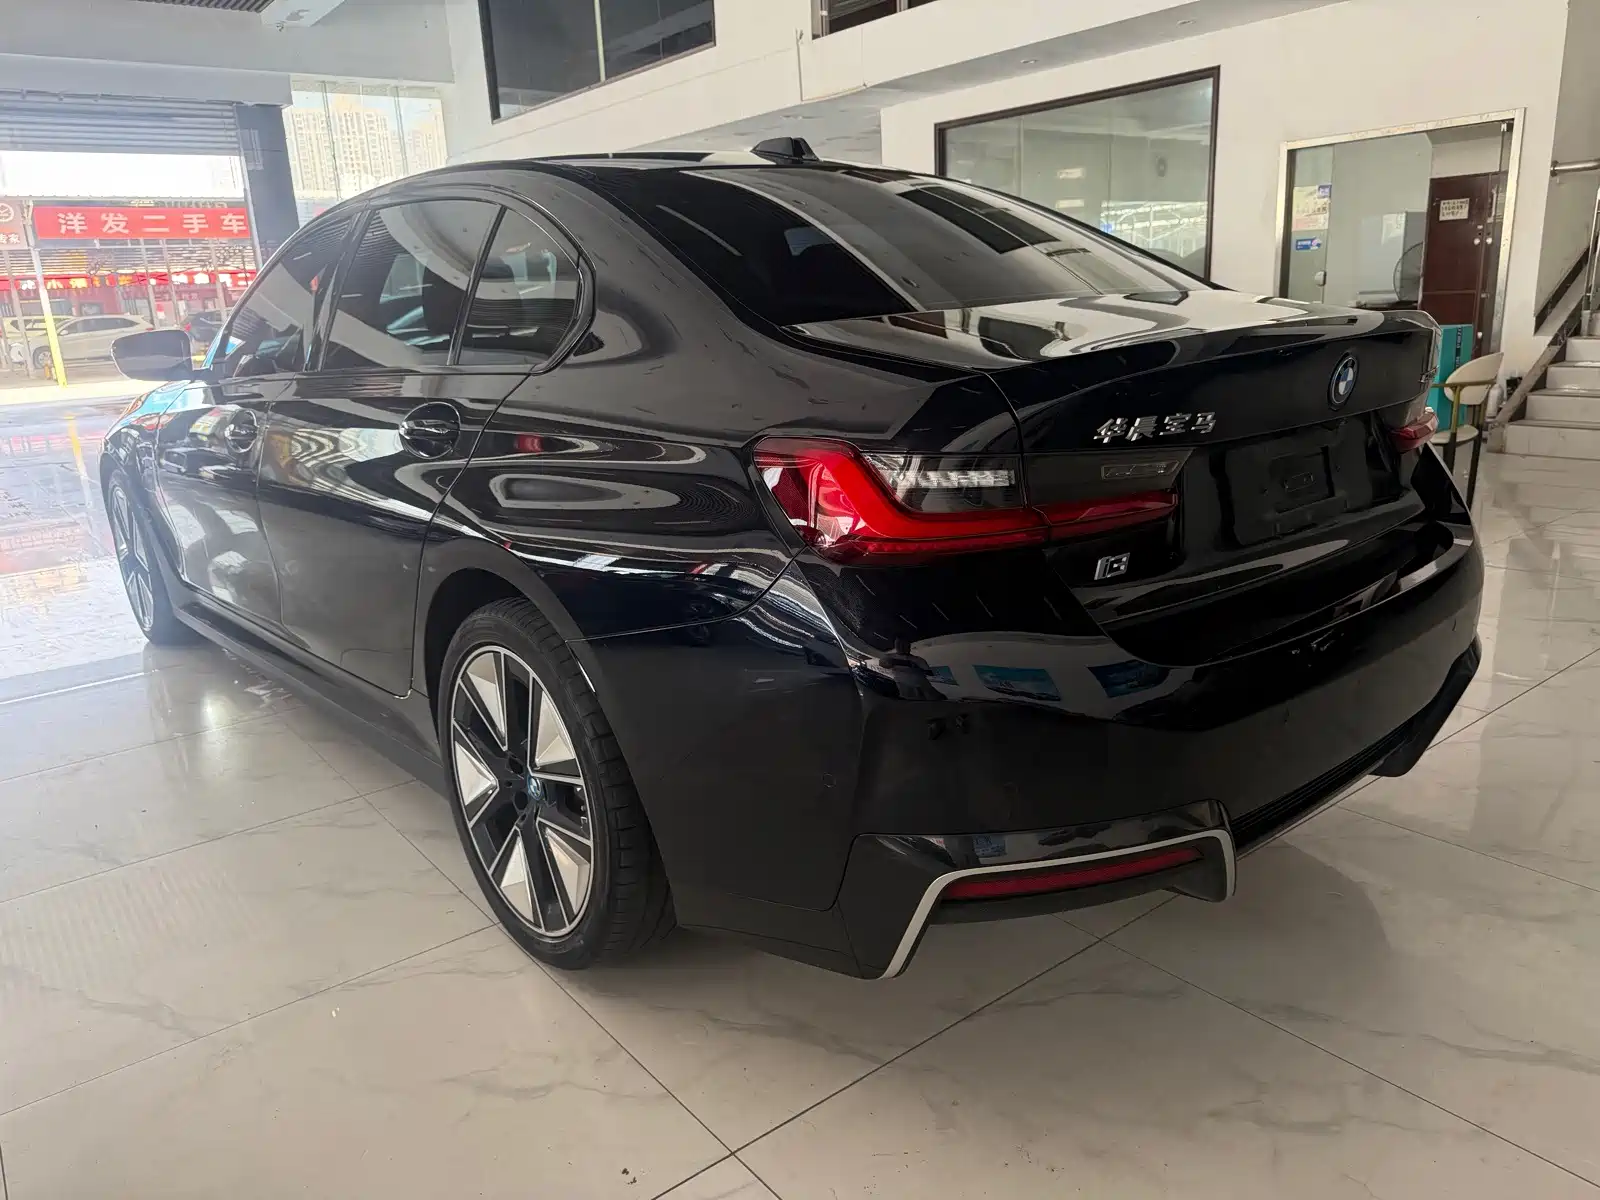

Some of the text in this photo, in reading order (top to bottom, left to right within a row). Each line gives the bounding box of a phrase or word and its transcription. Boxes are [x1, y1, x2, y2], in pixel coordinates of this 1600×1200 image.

[57, 212, 247, 234] 洋发二手车
[1093, 412, 1217, 444] 华晨宝马
